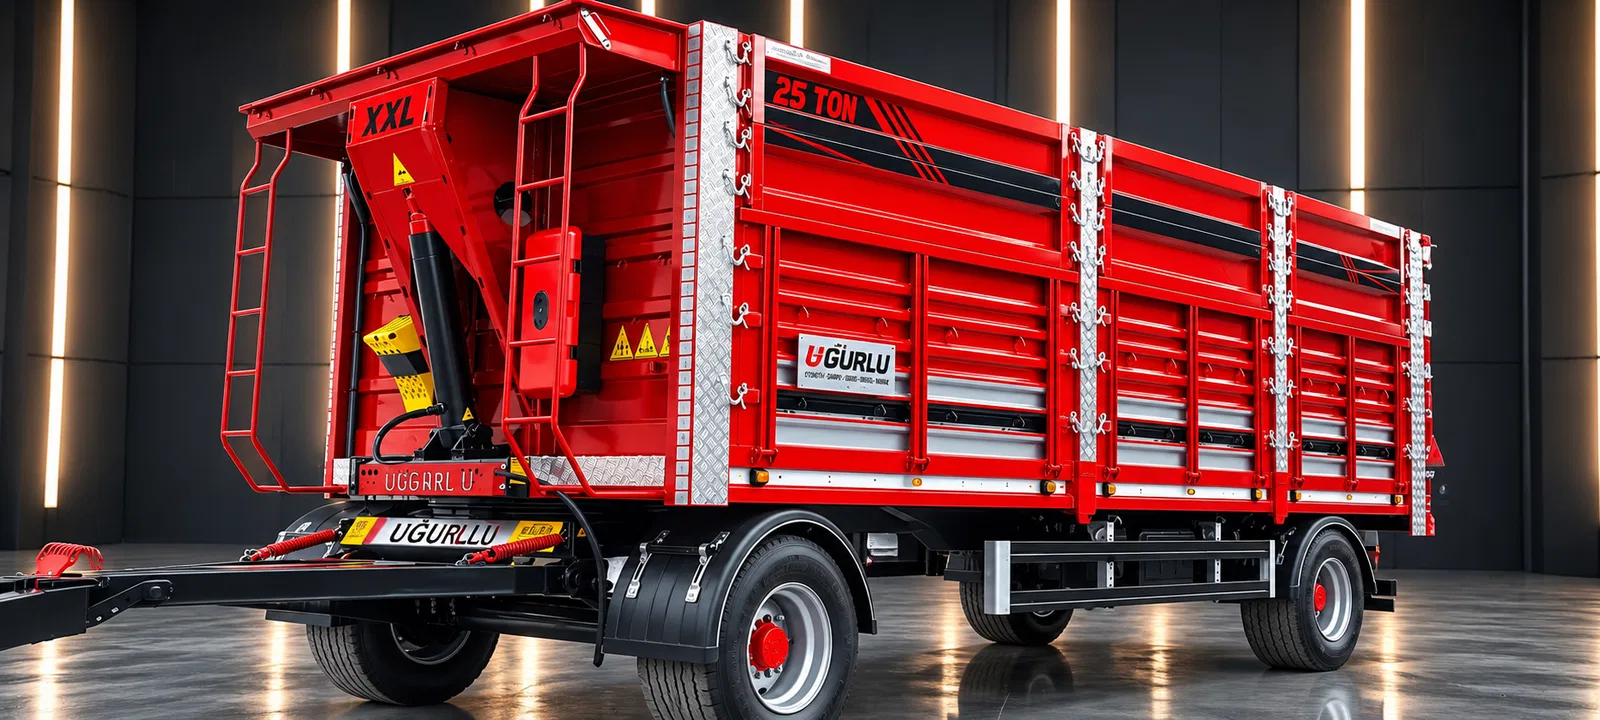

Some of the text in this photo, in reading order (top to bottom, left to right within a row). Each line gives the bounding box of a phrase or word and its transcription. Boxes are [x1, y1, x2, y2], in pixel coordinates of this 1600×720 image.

[361, 96, 415, 137] XXL
[773, 76, 858, 124] 25 TON
